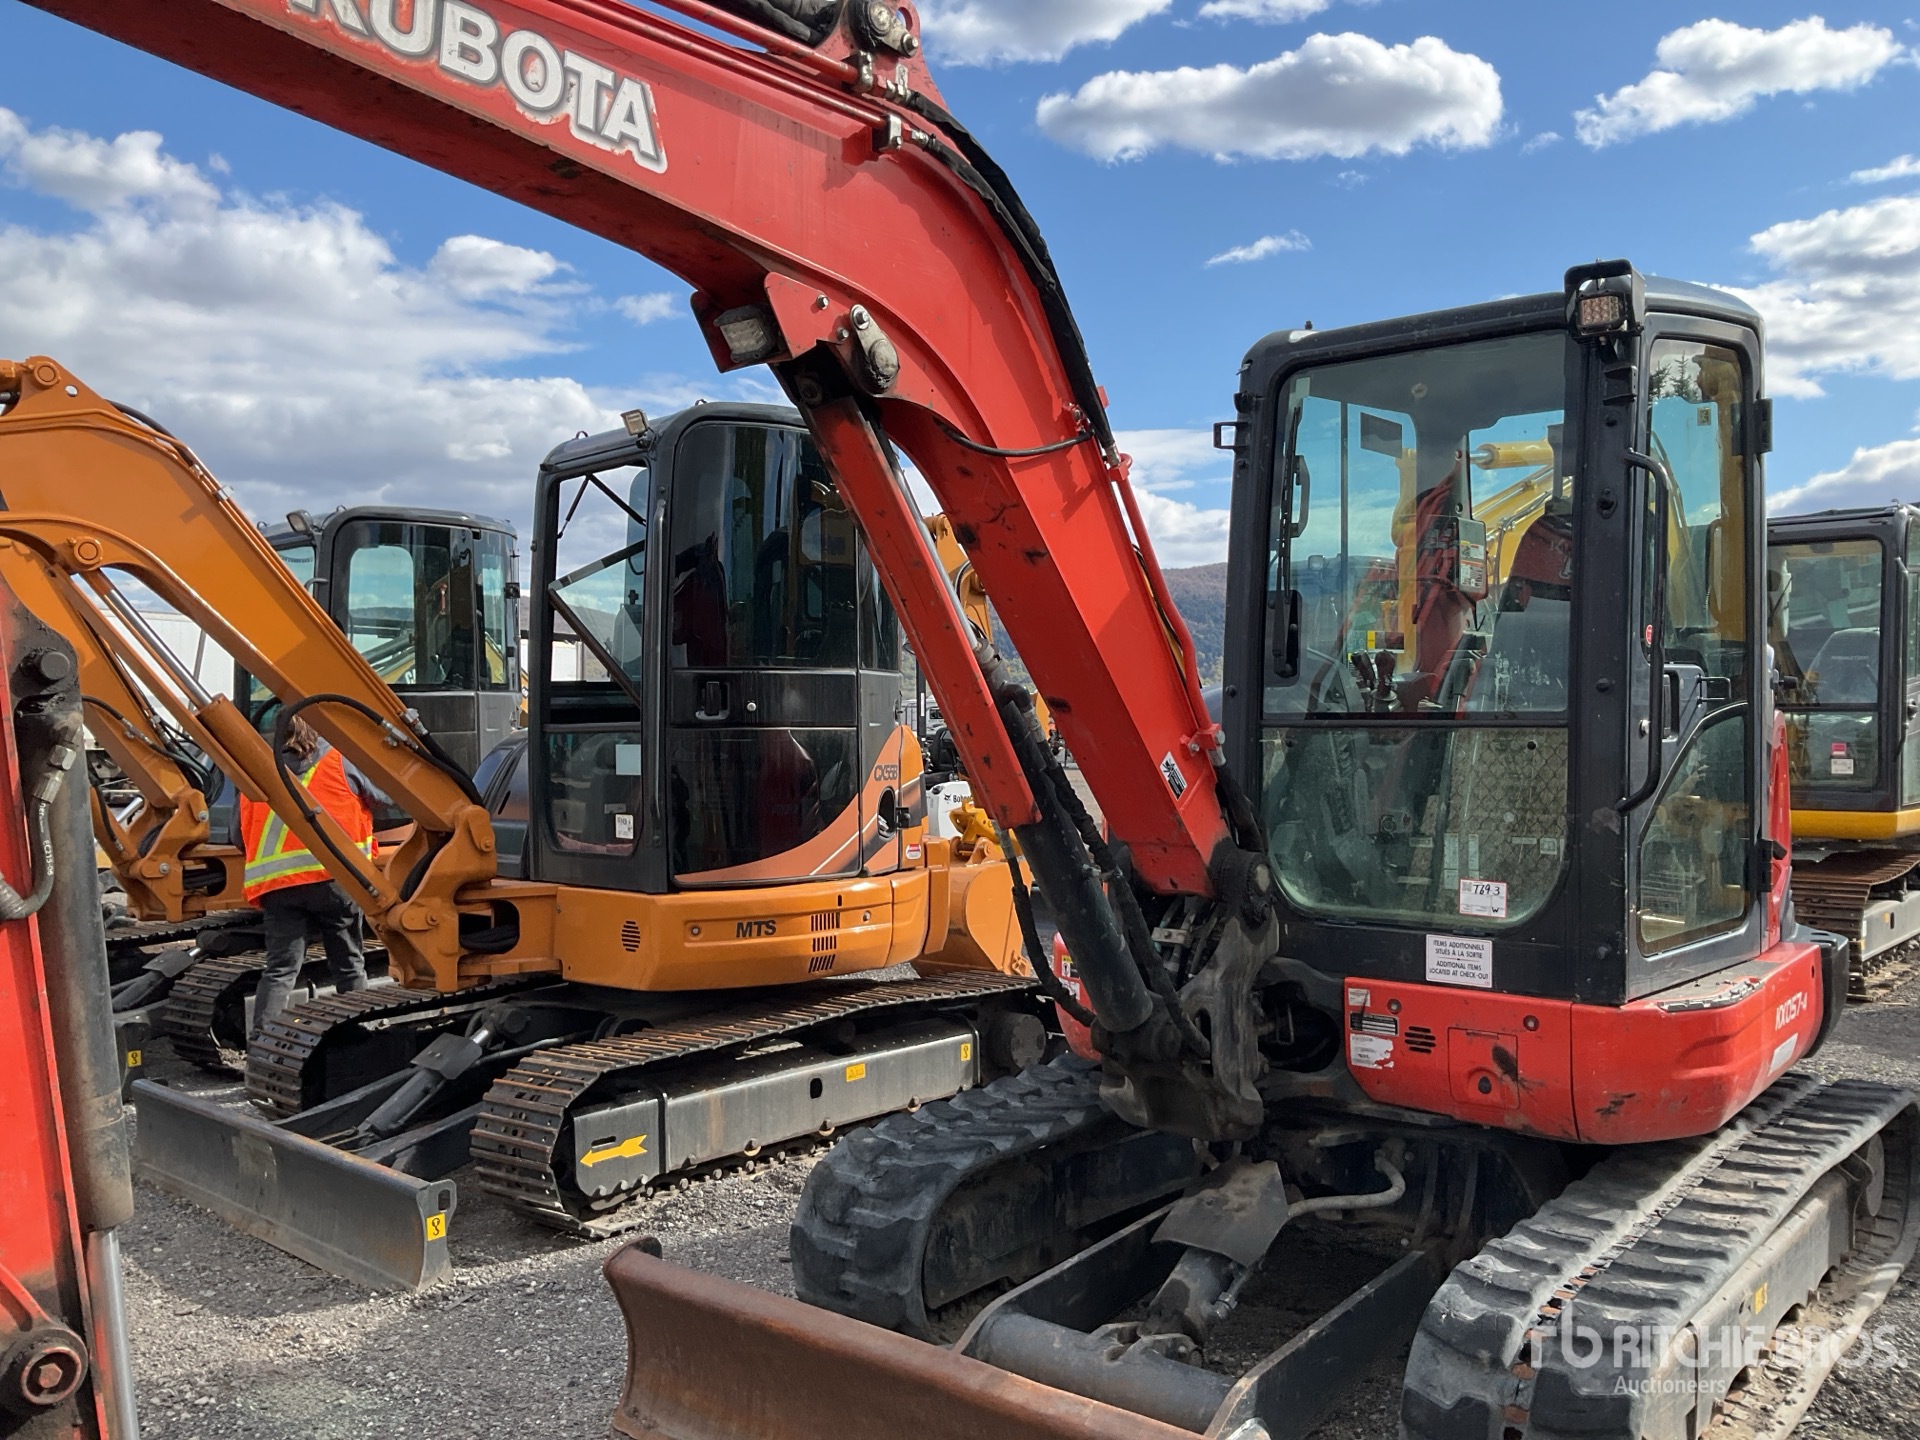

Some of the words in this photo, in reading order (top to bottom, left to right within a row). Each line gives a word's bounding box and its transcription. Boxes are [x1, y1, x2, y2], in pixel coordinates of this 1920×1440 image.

[736, 919, 777, 938] MTS
[1433, 939, 1447, 947] ITEMS
[1449, 942, 1485, 951] ADDITIONNELS
[1466, 951, 1482, 959] SORTIE
[1436, 961, 1466, 969] ADDITIONAL
[1467, 963, 1482, 971] ITEMS
[1775, 992, 1808, 1031] KX057-4
